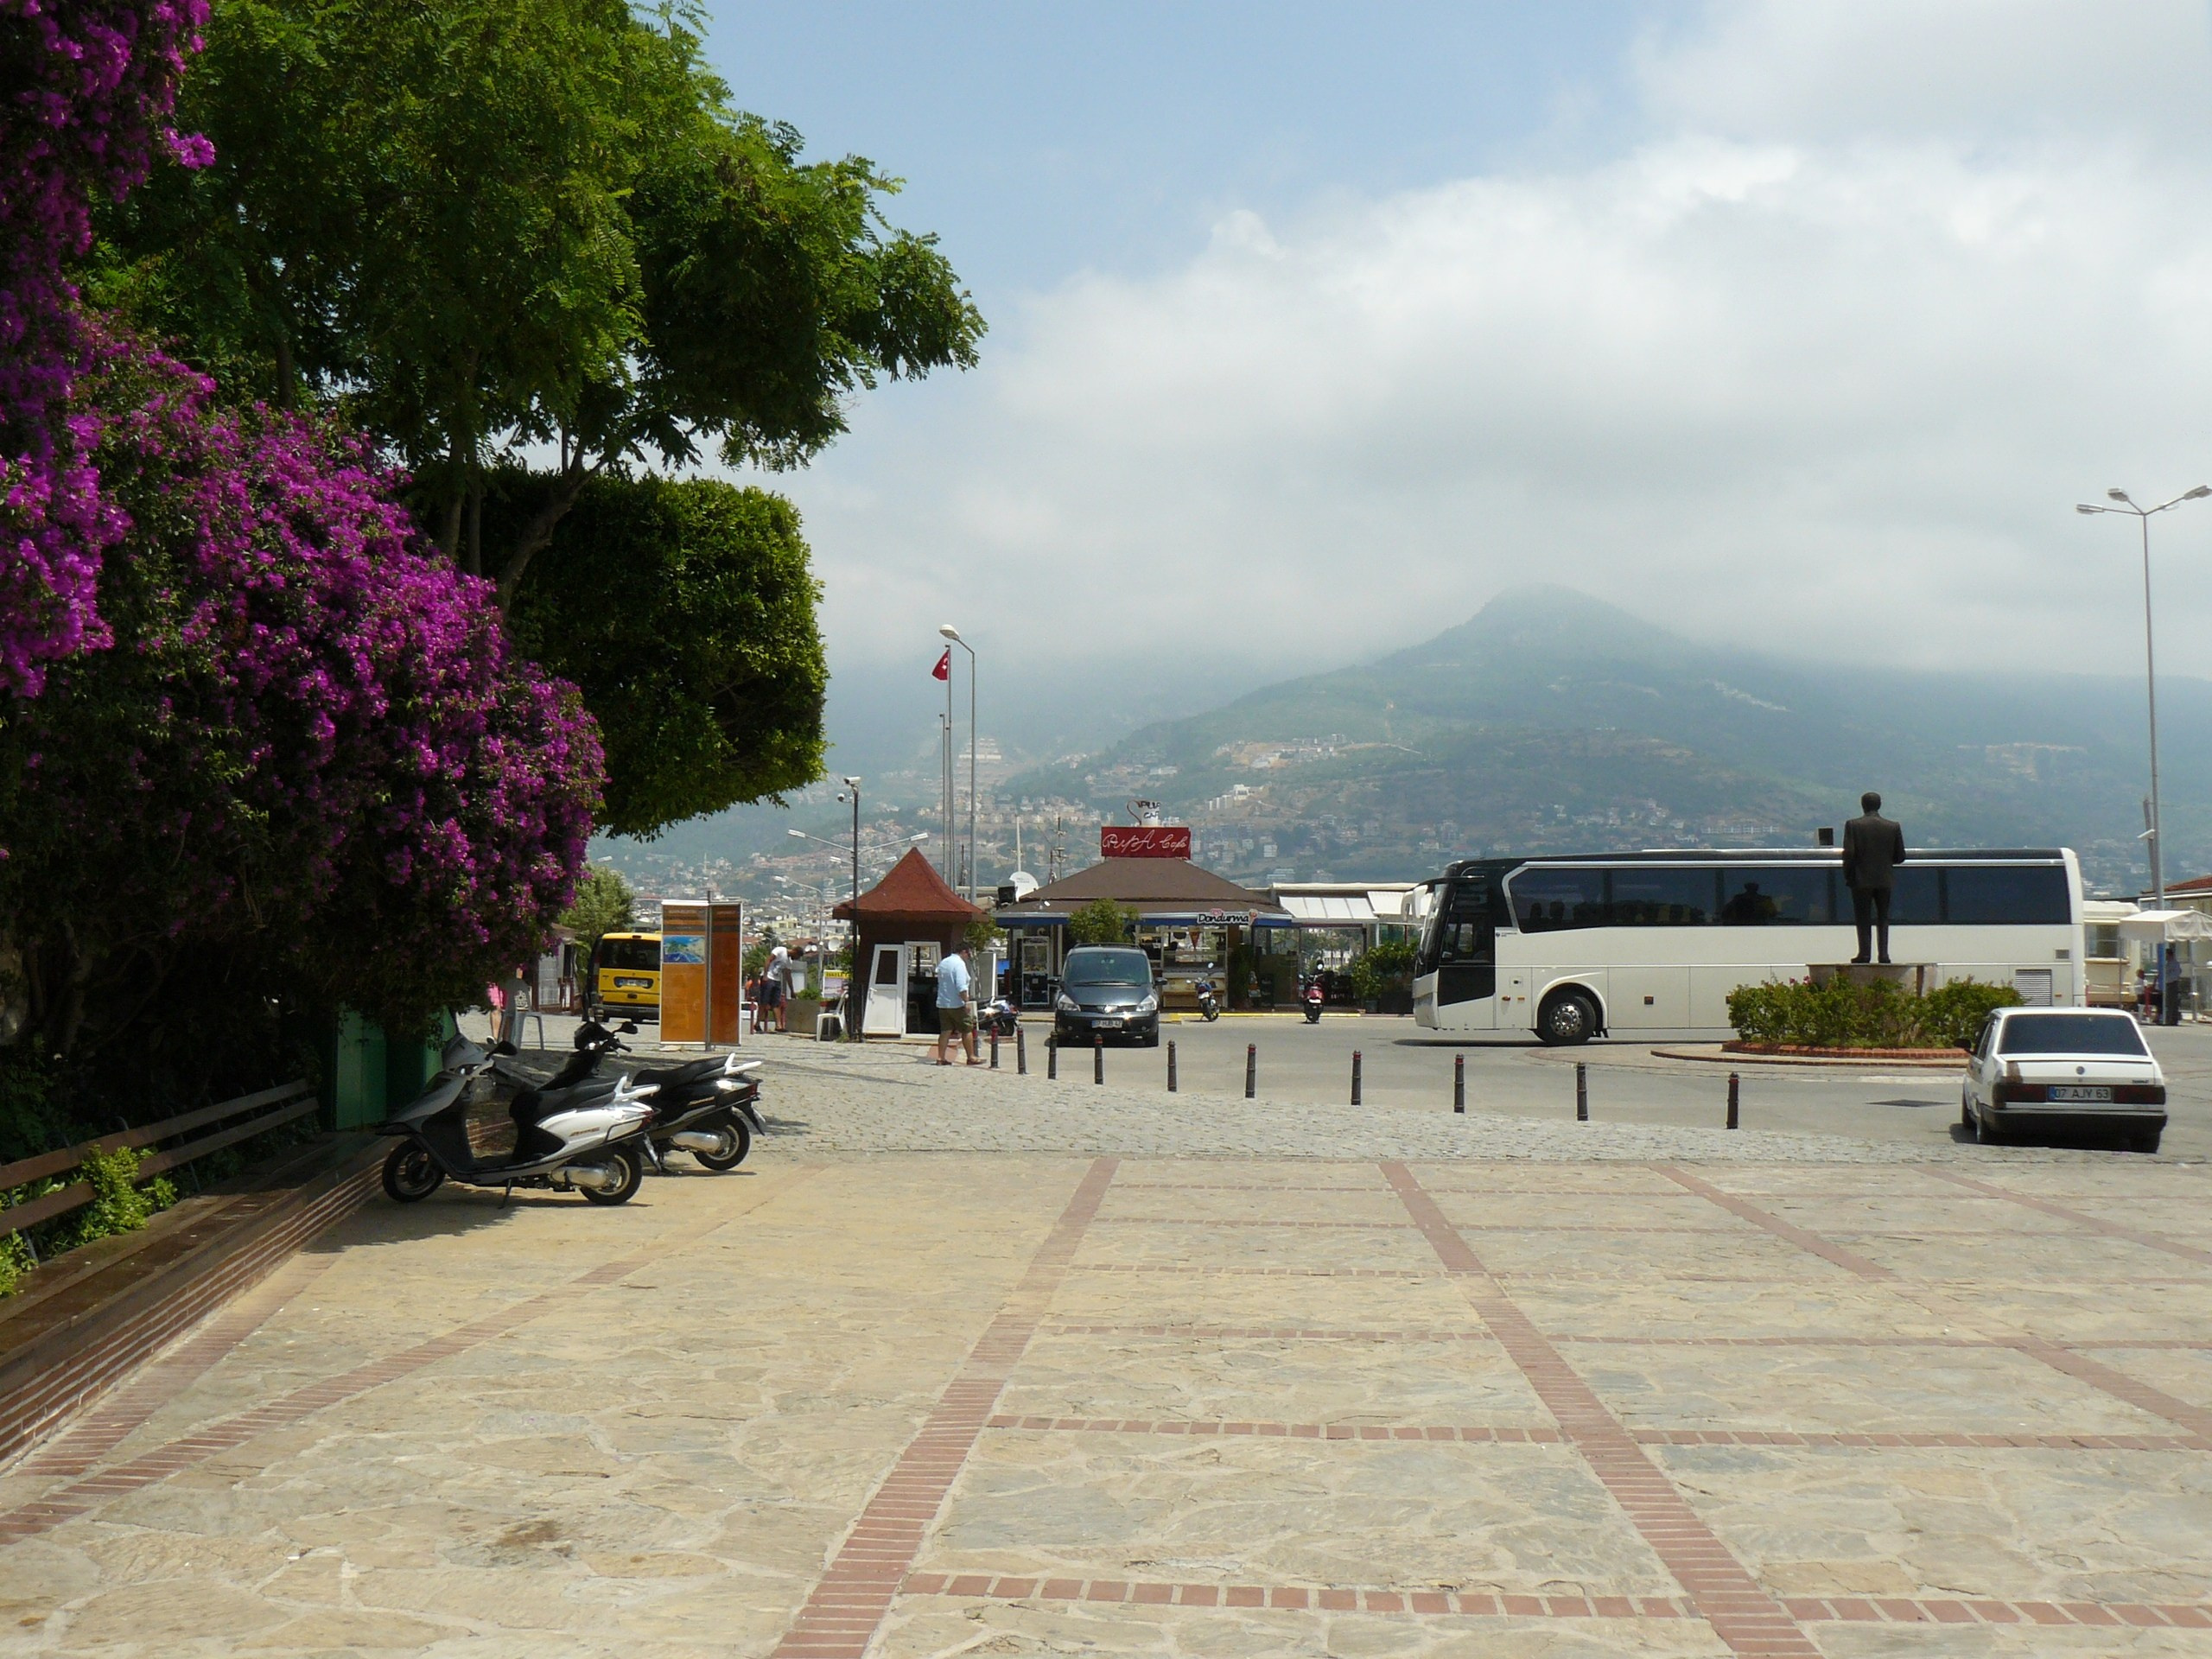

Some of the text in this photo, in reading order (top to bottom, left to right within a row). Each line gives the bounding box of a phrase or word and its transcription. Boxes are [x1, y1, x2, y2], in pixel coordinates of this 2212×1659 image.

[1198, 912, 1249, 923] Dondurma
[2056, 1088, 2108, 1099] 07 AJY 63
